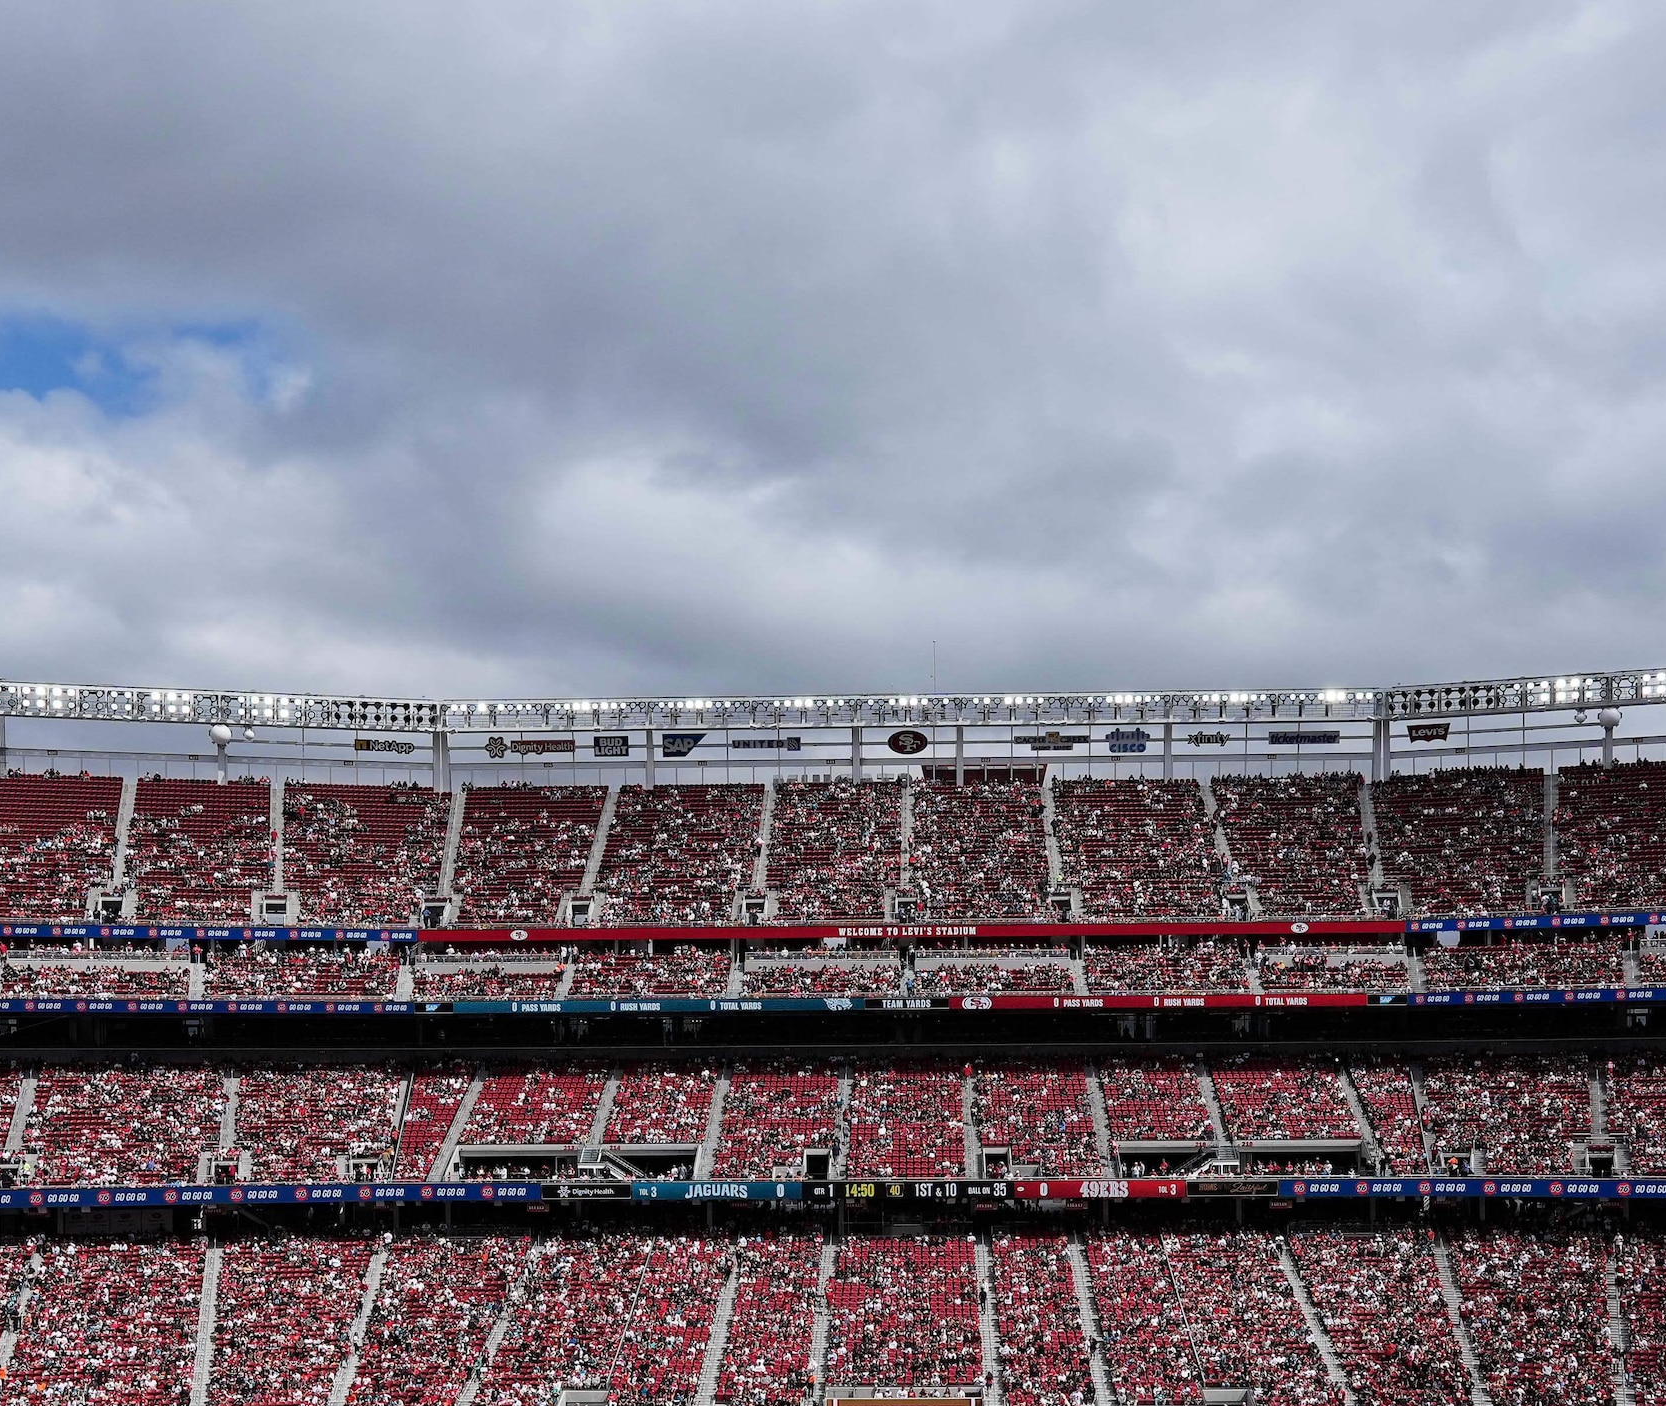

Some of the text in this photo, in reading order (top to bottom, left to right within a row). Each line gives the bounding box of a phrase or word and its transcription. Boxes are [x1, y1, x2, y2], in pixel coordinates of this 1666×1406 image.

[597, 736, 625, 746] BUD
[1014, 736, 1089, 745] CACHE CREEK
[1187, 731, 1230, 746] xfinity
[1270, 732, 1340, 744] ticketmaster
[511, 740, 575, 753] Dignity Health
[663, 737, 694, 752] SAP
[733, 739, 783, 749] UNITED
[594, 745, 628, 756] LIGHT
[838, 926, 977, 937] WELCOME TO LEVI'S STADIUM
[611, 1001, 661, 1012] 0 RUSH YARDS
[710, 1000, 762, 1011] 0 TOTAL YARDS
[882, 999, 931, 1009] TEAM YARDS
[1053, 997, 1104, 1008] 0 PASS YARDS
[1154, 997, 1205, 1007] 0 RUSH YARDS
[1255, 996, 1308, 1006] 0 TOTAL YARDS
[512, 1002, 561, 1013] 0 PASS YARDS
[572, 1187, 615, 1197] Dignity Health
[650, 1186, 657, 1197] 3
[684, 1183, 749, 1199] JAGUARS
[776, 1184, 784, 1198] 0
[814, 1184, 834, 1197] QTR 1
[845, 1184, 875, 1198] 14:50
[889, 1185, 901, 1196] 40
[915, 1184, 957, 1197] 1ST & 10
[967, 1184, 1007, 1197] BALL ON 35
[1039, 1183, 1048, 1197] 0
[1079, 1181, 1129, 1199] 49ERS
[1170, 1184, 1177, 1196] 3
